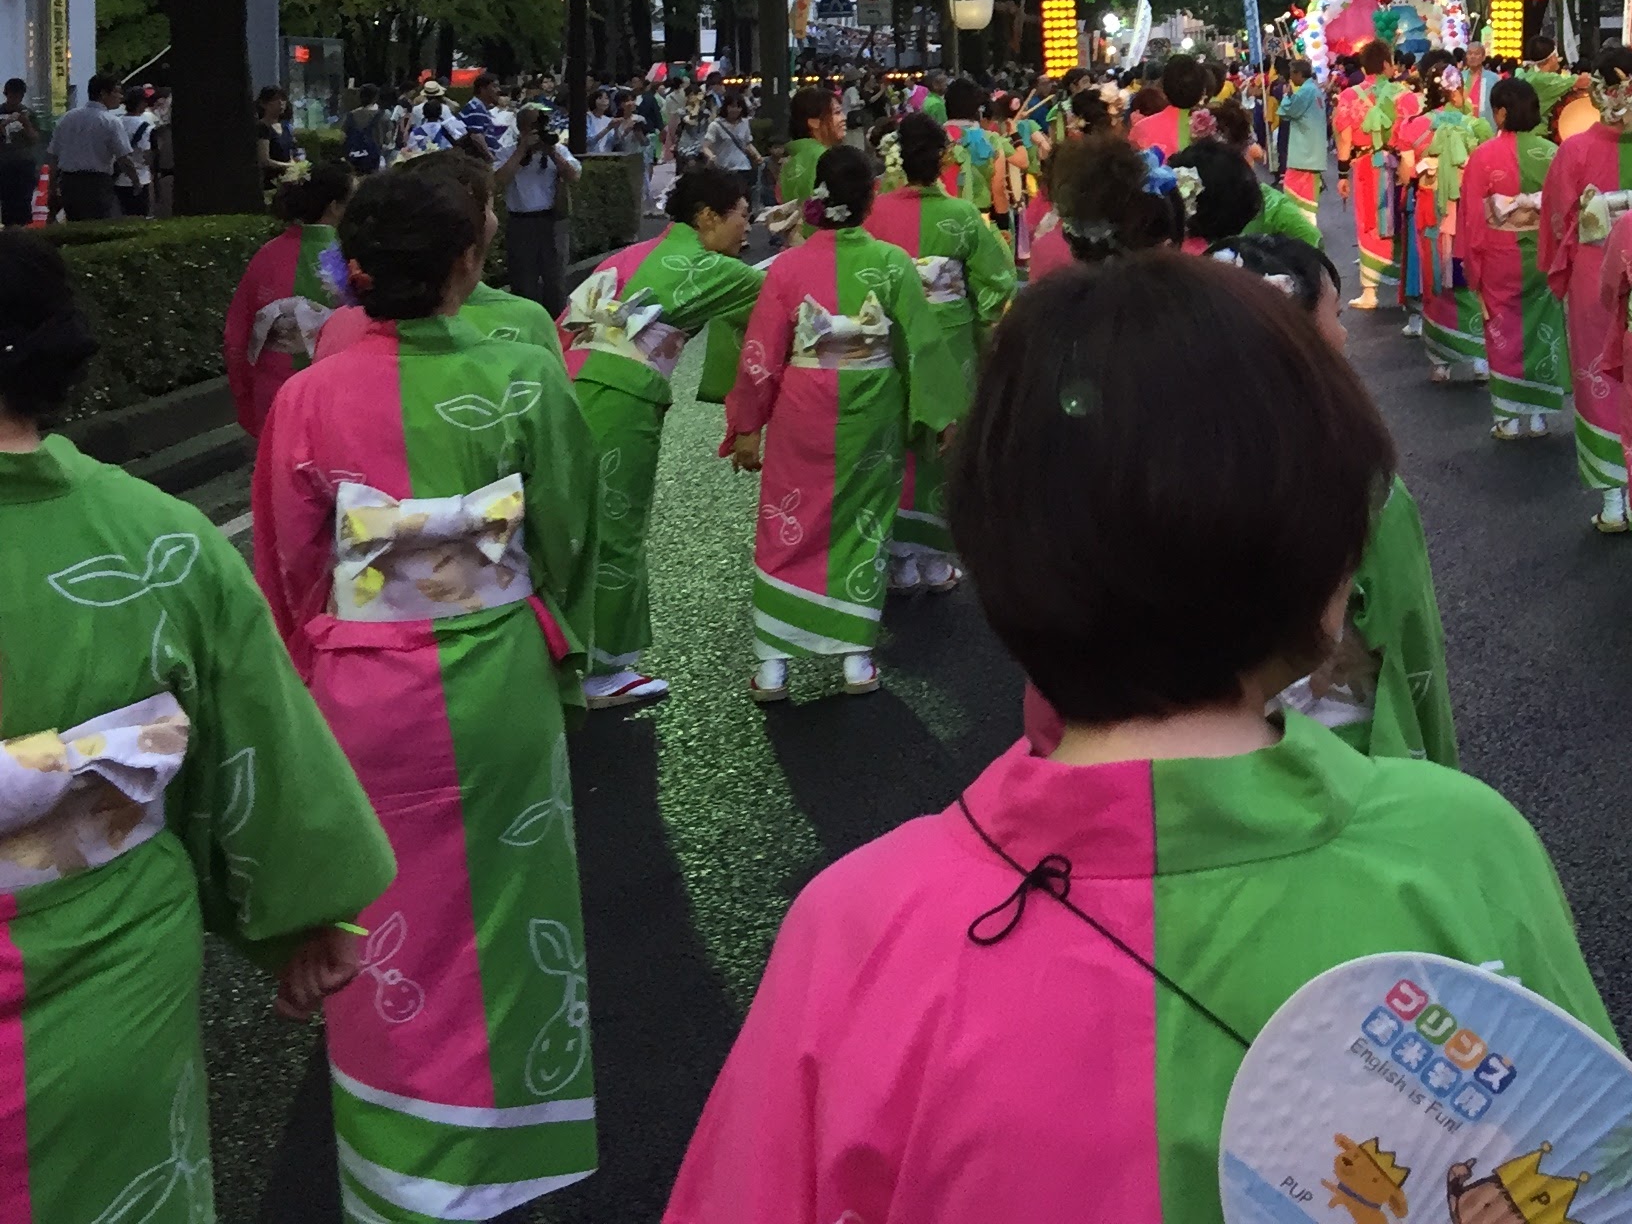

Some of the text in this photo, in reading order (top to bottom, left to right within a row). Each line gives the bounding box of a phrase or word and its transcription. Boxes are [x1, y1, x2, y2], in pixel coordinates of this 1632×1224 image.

[1348, 1035, 1464, 1135] English is Fun!
[1279, 1174, 1314, 1204] PUP
